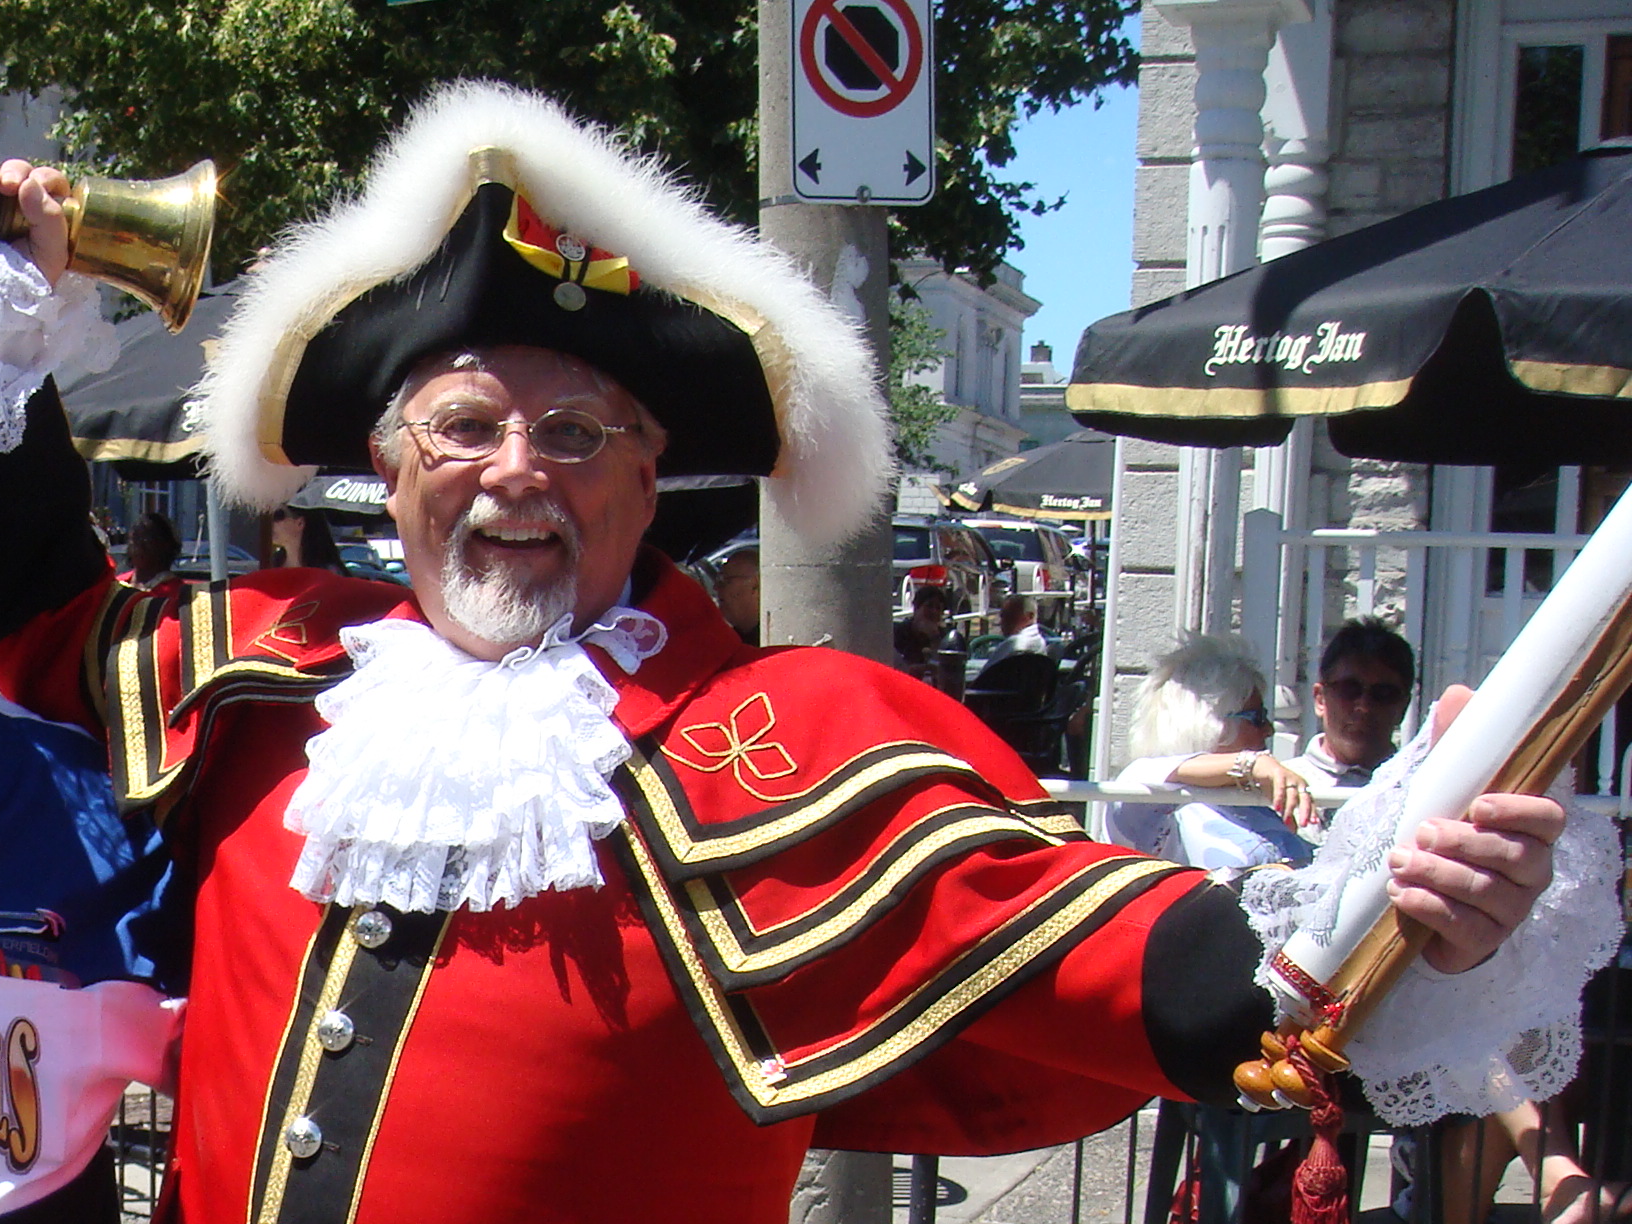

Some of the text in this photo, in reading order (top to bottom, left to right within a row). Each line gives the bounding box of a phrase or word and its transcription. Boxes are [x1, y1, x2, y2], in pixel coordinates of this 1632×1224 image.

[1203, 320, 1367, 376] Hertog Jan
[326, 478, 389, 504] GUINNE
[1040, 494, 1103, 510] Hertog Jan
